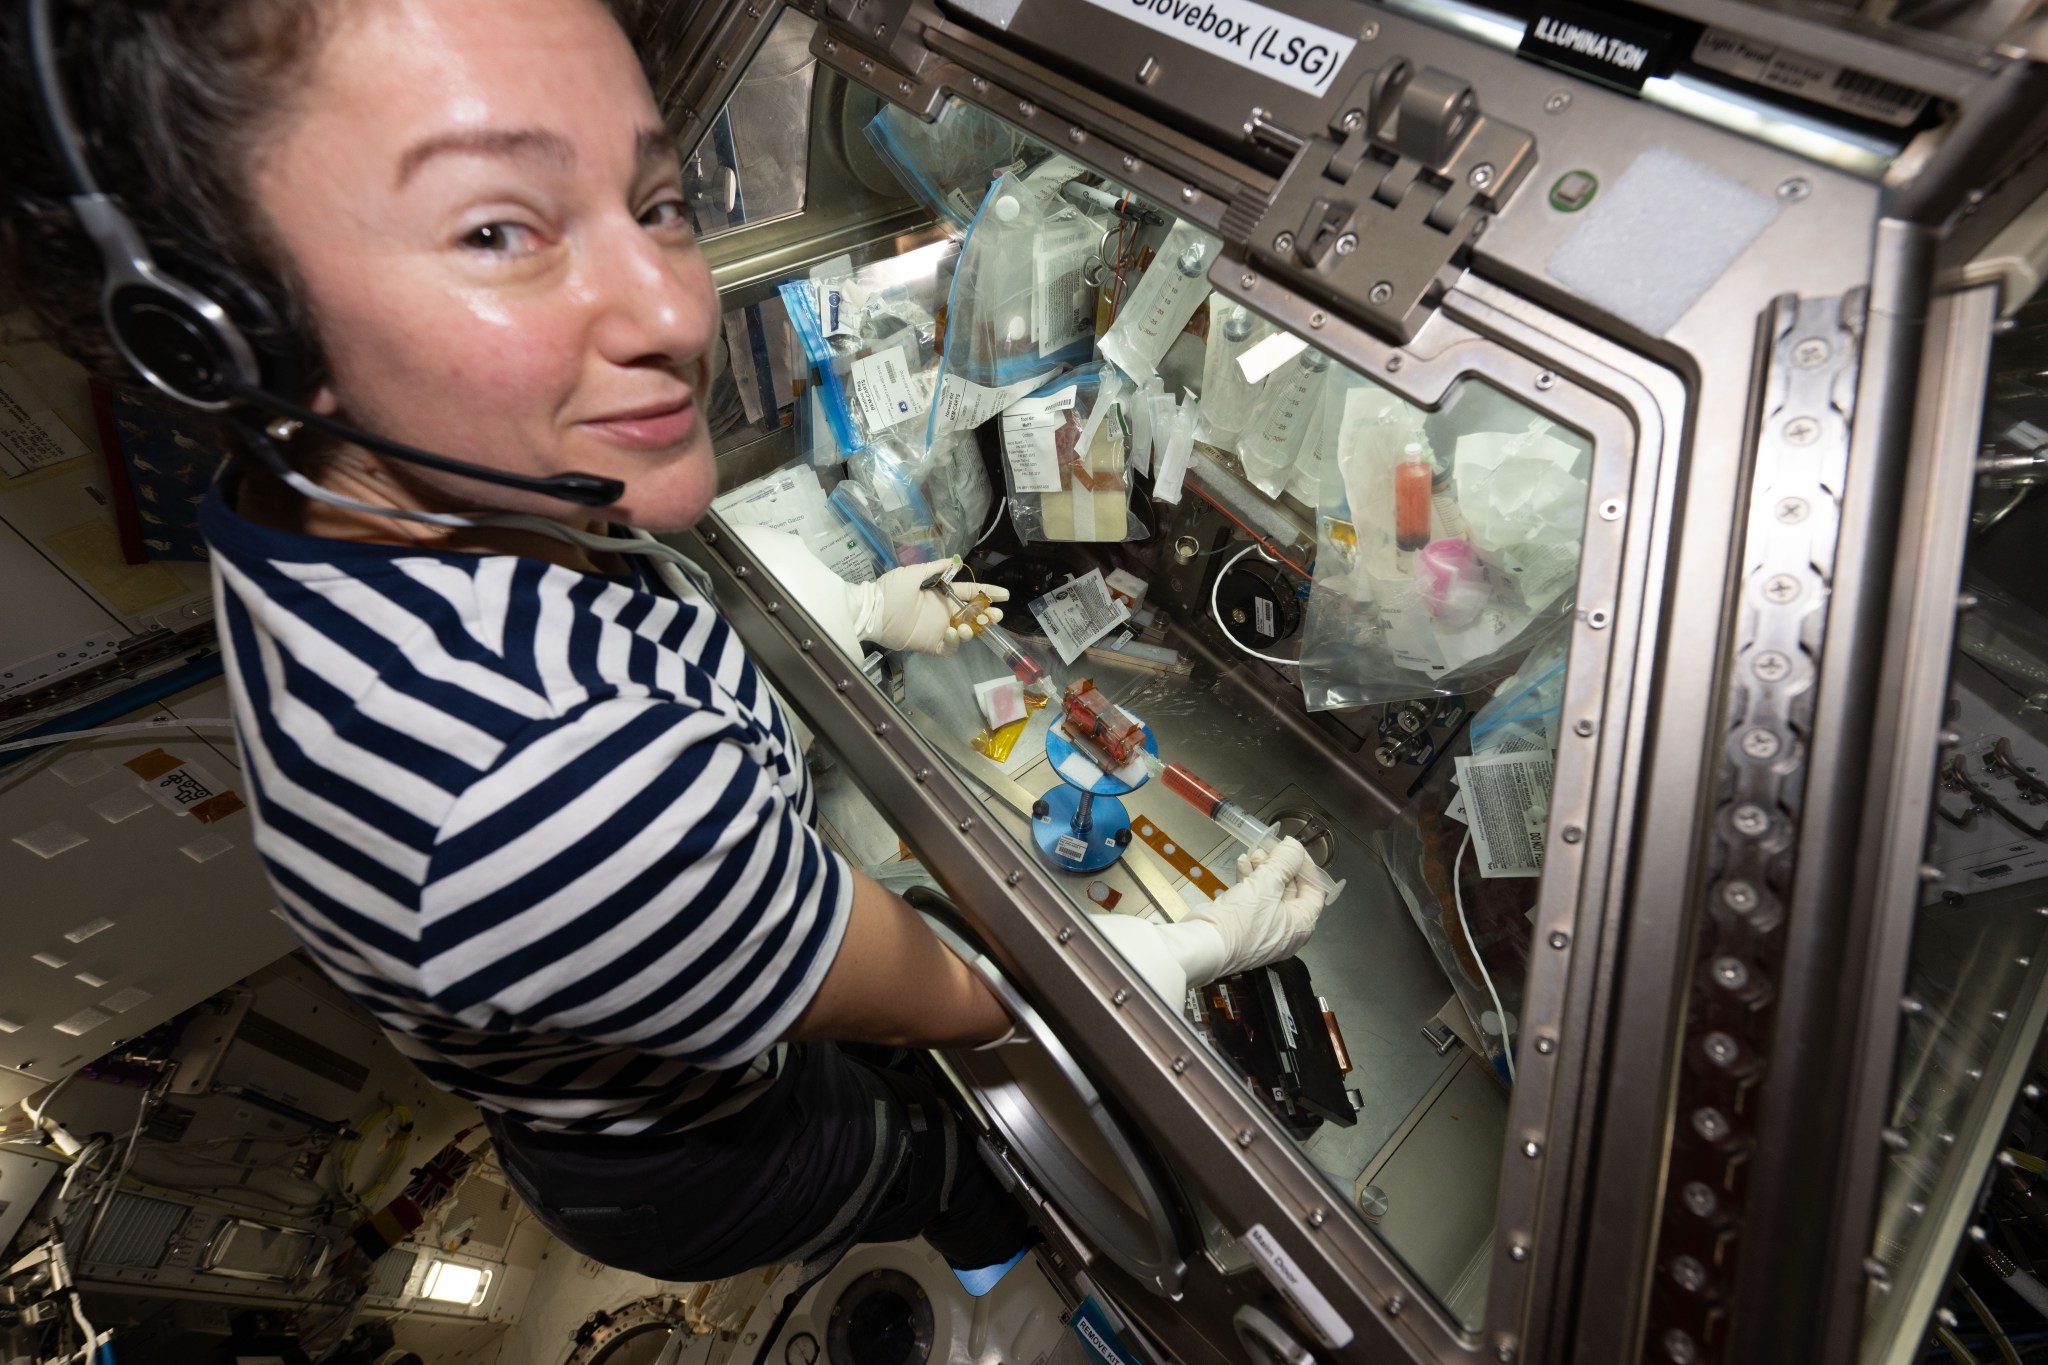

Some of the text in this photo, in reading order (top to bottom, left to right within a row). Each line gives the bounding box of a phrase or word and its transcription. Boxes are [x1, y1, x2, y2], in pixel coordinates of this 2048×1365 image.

[1250, 25, 1339, 86] (LSG)
[1534, 16, 1649, 72] ILLUMINATION
[1513, 763, 1522, 784] CAUTION
[1530, 832, 1542, 841] DO
[1532, 840, 1544, 853] NOT
[1252, 1230, 1298, 1284] Main Door
[1079, 1320, 1120, 1365] REMOVE KIT
